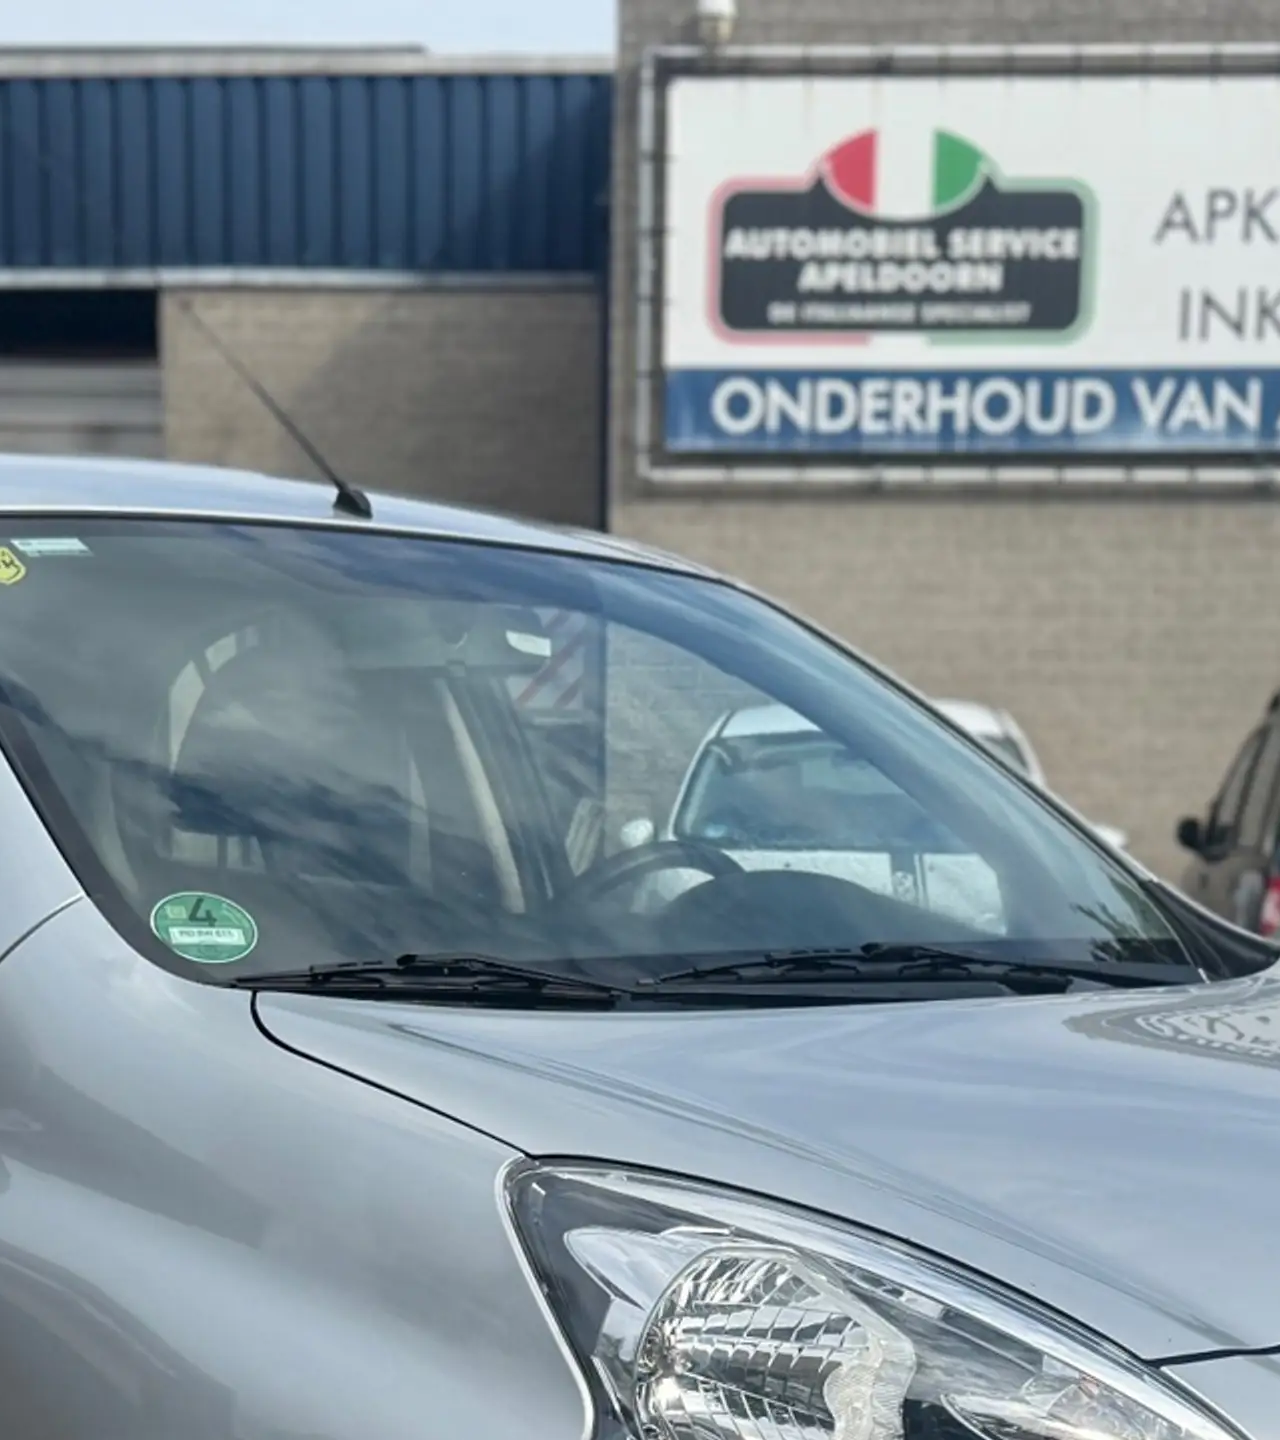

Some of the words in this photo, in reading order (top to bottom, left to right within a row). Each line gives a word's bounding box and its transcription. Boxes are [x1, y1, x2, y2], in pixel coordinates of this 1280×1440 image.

[1154, 187, 1280, 244] APK
[723, 227, 942, 260] AUTOMOBIEL
[946, 228, 1081, 261] SERVICE
[796, 262, 1005, 293] APELDOORN
[710, 376, 1118, 435] ONDERHOUD
[1130, 376, 1263, 434] VAN
[188, 897, 218, 927] 4
